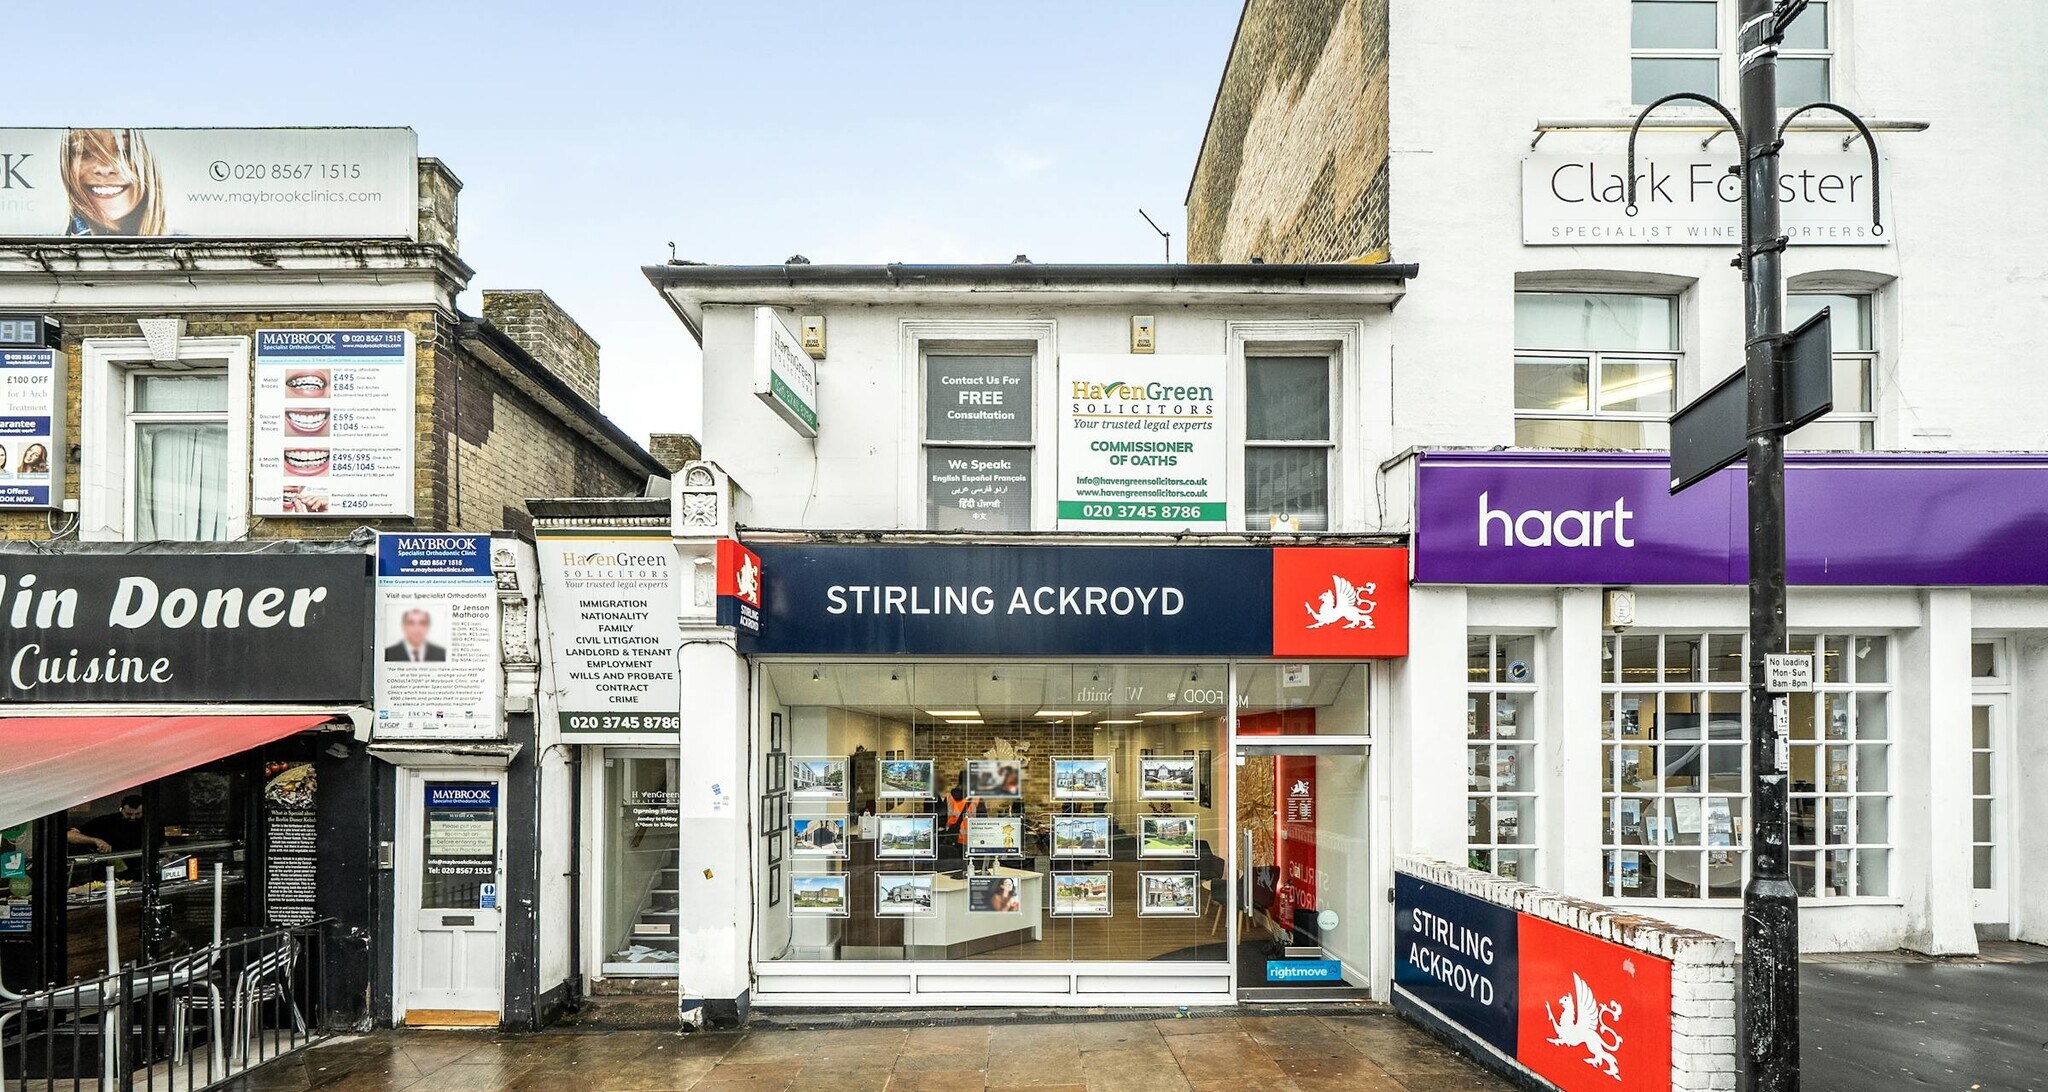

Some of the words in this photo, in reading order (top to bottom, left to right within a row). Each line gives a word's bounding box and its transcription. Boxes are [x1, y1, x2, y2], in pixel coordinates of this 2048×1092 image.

[234, 163, 266, 180] 020
[271, 163, 312, 180] 8567
[320, 163, 361, 180] 1515
[1551, 162, 1673, 203] Clark
[1691, 163, 1863, 203] Foster
[187, 190, 382, 204] www.maybrookclinics.com
[1552, 226, 1673, 238] SPECIALIST
[1687, 226, 1735, 238] WINE
[1786, 226, 1866, 238] ORTERS
[263, 334, 336, 344] MAYBROOK
[7, 376, 29, 384] £100
[31, 376, 48, 384] OFF
[941, 376, 984, 385] Contact
[986, 376, 1000, 385] Us
[1002, 376, 1021, 385] For
[1072, 381, 1214, 401] HavenGreen
[958, 391, 1004, 405] FREE
[8, 403, 47, 411] Treatment
[1073, 403, 1213, 414] SOLICITORS
[947, 410, 1015, 420] Consultation
[333, 423, 359, 431] £1045
[1073, 419, 1100, 429] Your
[1102, 420, 1141, 430] trusted
[1143, 420, 1170, 432] legal
[1173, 421, 1213, 432] experts
[1090, 441, 1194, 453] COMMISSIONER
[332, 454, 371, 462] £495/595
[1109, 455, 1128, 466] OF
[1131, 455, 1178, 466] OATHS
[332, 463, 375, 471] £845/1045
[948, 460, 968, 469] We
[971, 460, 1012, 471] Speak:
[932, 475, 960, 484] English
[962, 474, 992, 484] Español
[994, 475, 1027, 484] Français
[1076, 477, 1208, 486] Info@havengreensolicitors.co.uk
[1076, 488, 1208, 498] www.havengreensolicitors.co.uk
[342, 500, 368, 508] £2450
[1083, 505, 1113, 517] 020
[1118, 506, 1156, 518] 3745
[1161, 506, 1201, 518] 8786
[1479, 490, 1635, 548] haart
[398, 538, 477, 550] MAYBROOK
[563, 552, 667, 567] HavenGreen
[564, 570, 669, 578] SOLICITORS
[565, 580, 585, 588] Your
[586, 581, 616, 589] trusted
[617, 581, 637, 590] legal
[638, 581, 668, 590] experts
[109, 576, 328, 629] Doner
[579, 600, 648, 608] IMMIGRATION
[826, 586, 994, 616] STIRLING
[1006, 586, 1184, 616] ACKROYD
[581, 612, 649, 620] NATIONALITY
[599, 624, 634, 632] FAMILY
[576, 636, 601, 644] CIVIL
[603, 636, 659, 645] LITIGATION
[566, 648, 620, 657] LANDLORD
[622, 649, 630, 657] &
[632, 649, 672, 657] TENANT
[10, 643, 173, 690] Cuisine
[1770, 658, 1780, 666] No
[1783, 658, 1809, 667] loading
[570, 672, 600, 680] WILLS
[602, 672, 625, 680] AND
[627, 672, 673, 680] PROBATE
[596, 684, 649, 692] CONTRACT
[609, 696, 639, 704] CRIME
[570, 717, 599, 729] 020
[602, 717, 640, 729] 3745
[643, 717, 680, 729] 8786
[433, 790, 490, 799] MAYBROOK
[1413, 907, 1494, 965] STIRLING
[1270, 967, 1328, 979] rightmove
[1409, 942, 1494, 1006] ACKROYD
